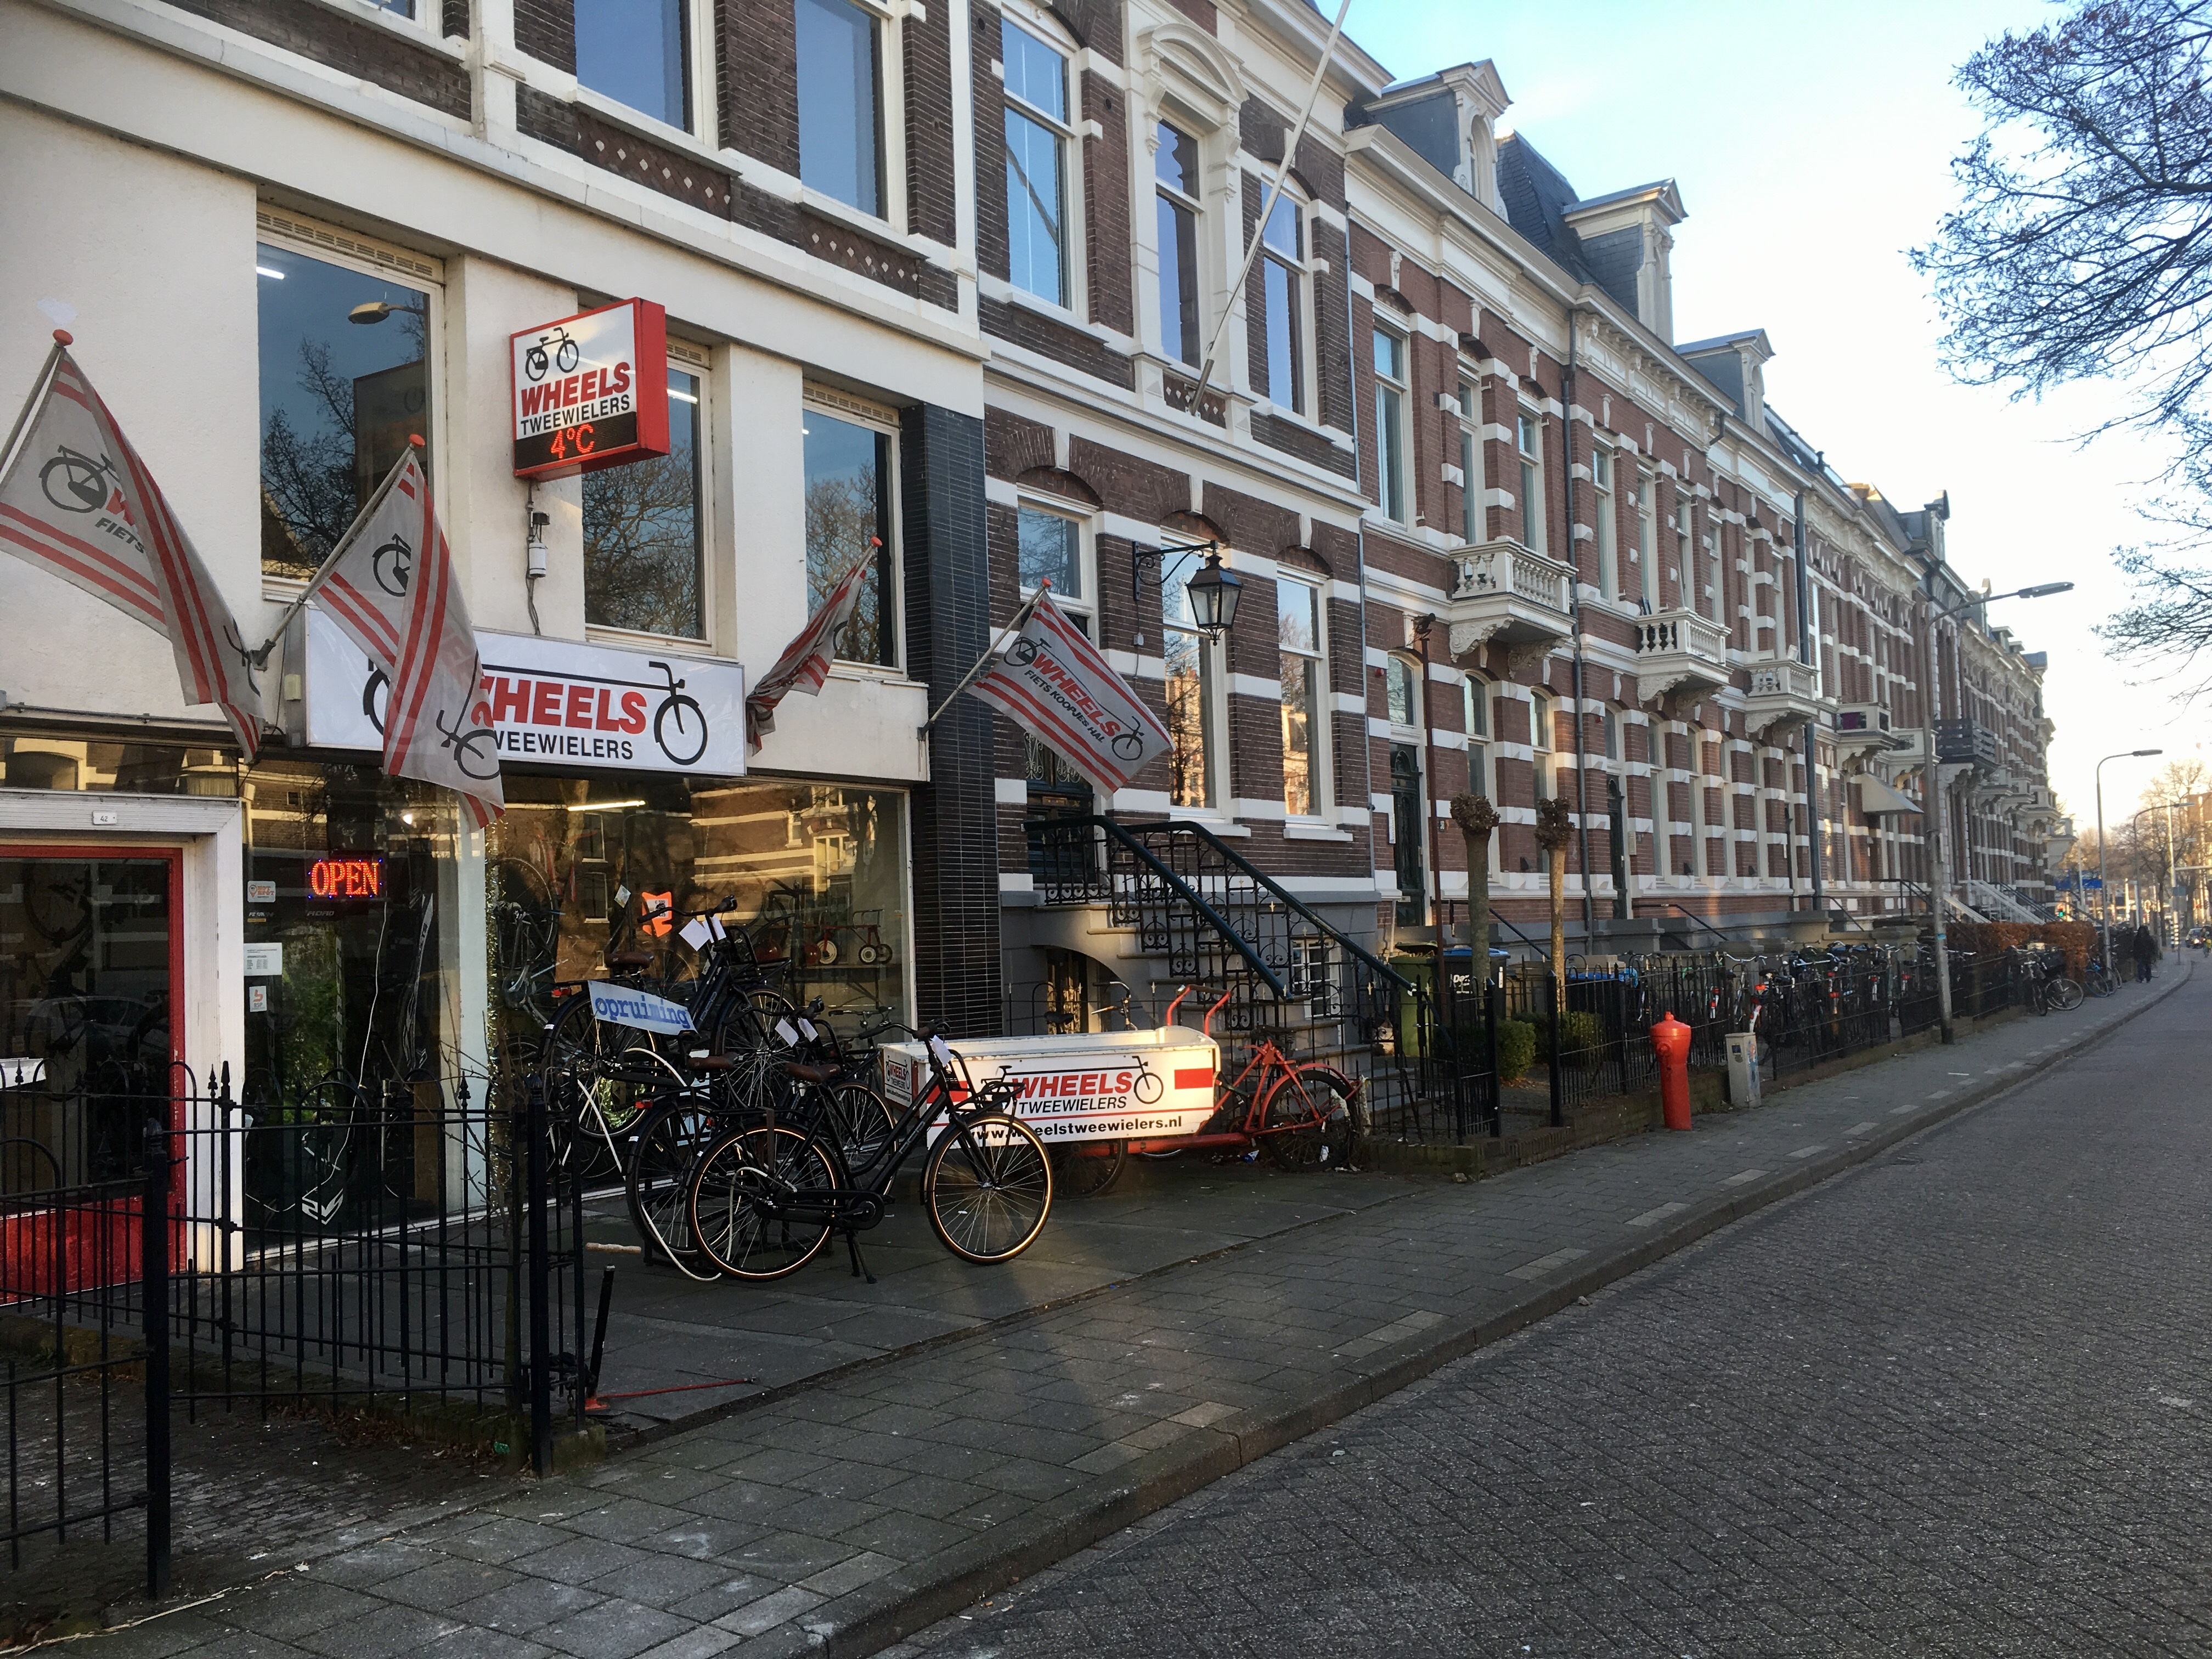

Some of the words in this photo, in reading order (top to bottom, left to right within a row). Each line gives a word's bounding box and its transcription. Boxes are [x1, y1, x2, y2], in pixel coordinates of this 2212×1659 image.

[521, 362, 630, 417] WHEELS
[520, 394, 630, 435] TWEEWIELERS
[95, 517, 145, 554] FIETS
[484, 676, 647, 735] HEELS
[1024, 669, 1053, 692] FIETS
[1049, 690, 1090, 727] KOOPJES
[1032, 652, 1121, 737] WHEELS
[494, 730, 634, 760] WEEWIELERS
[311, 861, 379, 896] OPEN
[595, 995, 691, 1029] opruiming
[1012, 1072, 1133, 1099] WHEELS
[1019, 1097, 1127, 1114] TWEEWIELERS
